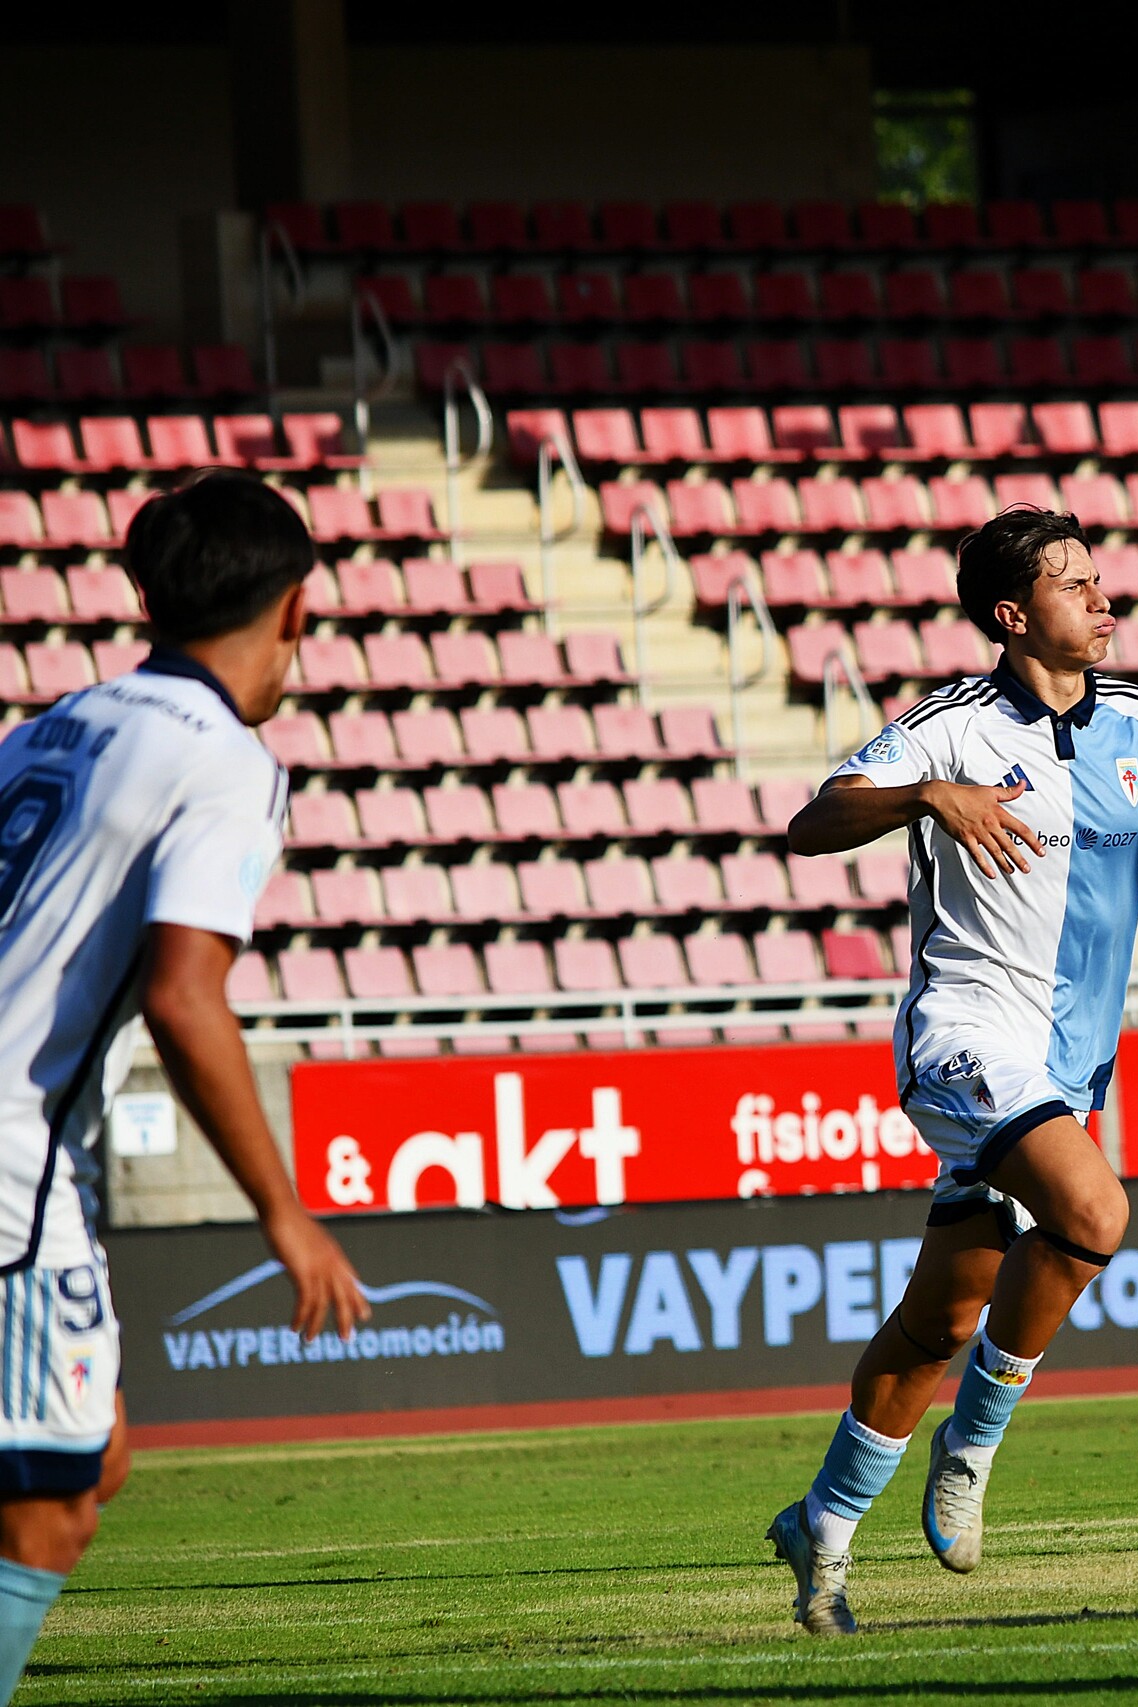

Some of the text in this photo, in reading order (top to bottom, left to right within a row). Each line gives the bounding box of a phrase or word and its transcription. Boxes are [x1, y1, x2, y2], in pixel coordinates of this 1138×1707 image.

[1103, 831, 1137, 848] 2027
[938, 1049, 986, 1085] 4
[58, 1265, 103, 1333] 9
